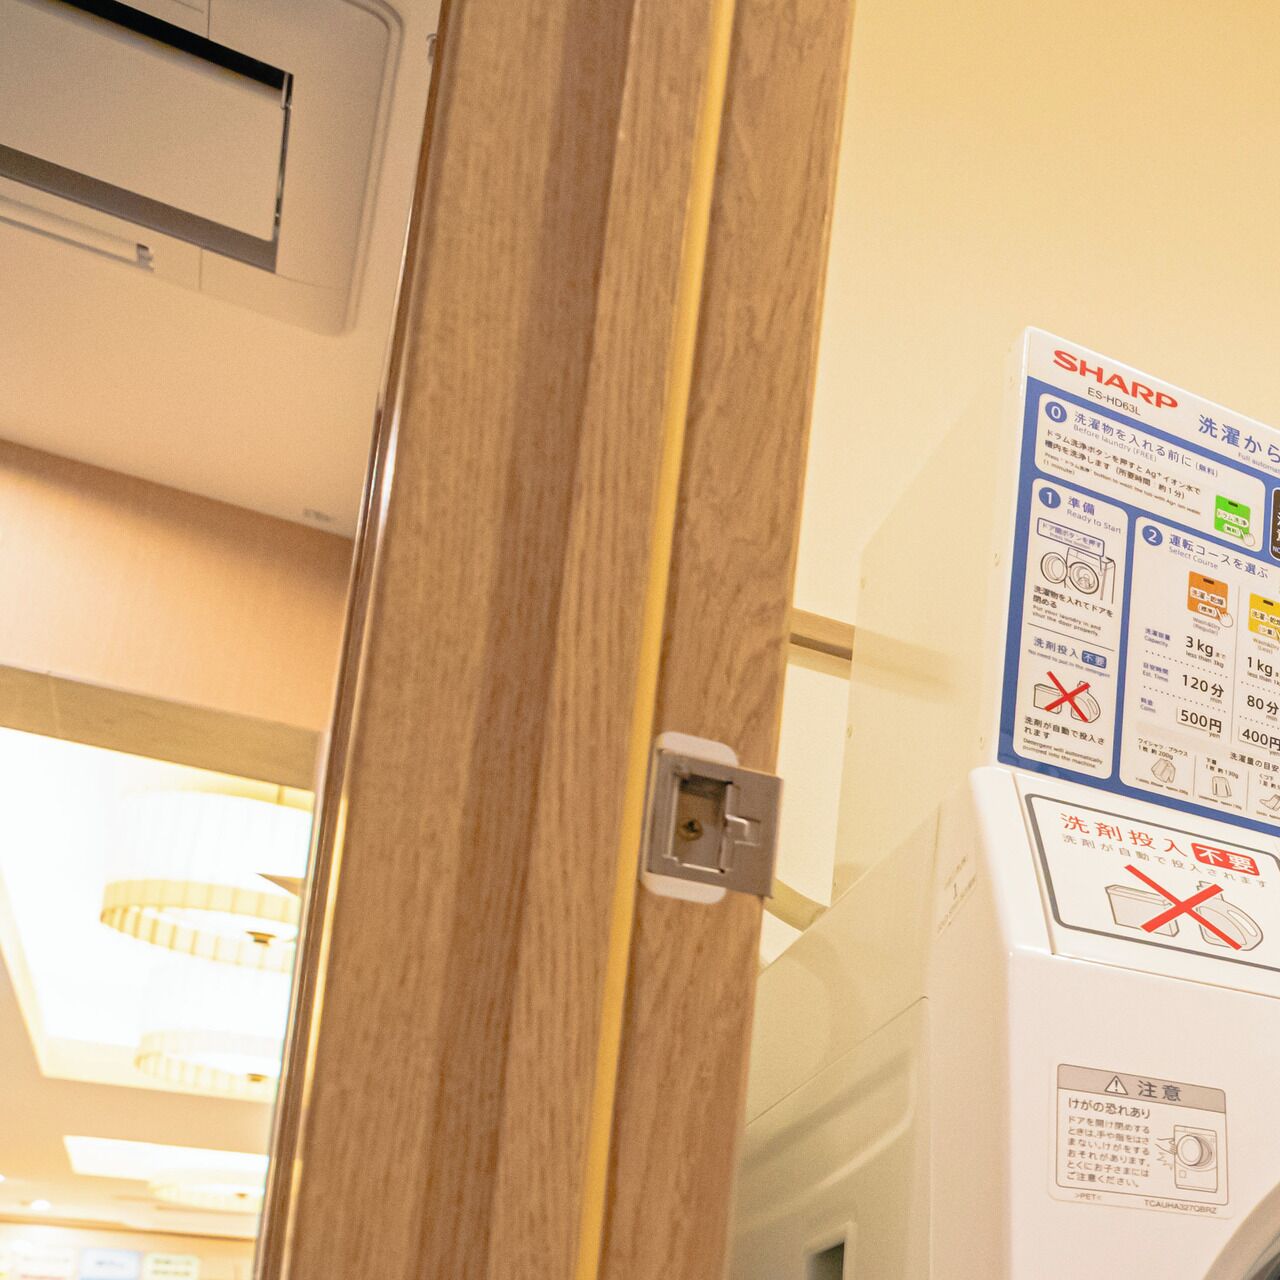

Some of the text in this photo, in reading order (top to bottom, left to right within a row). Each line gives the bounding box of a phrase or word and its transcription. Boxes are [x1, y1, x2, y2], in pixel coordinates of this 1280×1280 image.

[1053, 349, 1178, 409] SHARP
[1087, 385, 1141, 417] ES-HD63L
[1073, 423, 1099, 440] Before
[1100, 433, 1131, 453] laundry
[1073, 410, 1192, 469] 洗濯物を入れる前に
[1067, 495, 1095, 516] 準備
[1066, 508, 1121, 534] Ready to Start
[1168, 532, 1268, 581] 運転コースを選ぶ
[1168, 545, 1218, 570] Select Course
[1033, 635, 1079, 660] 洗剤投入
[1196, 638, 1213, 658] kg
[1256, 658, 1272, 678] kg
[1181, 672, 1224, 699] 120分
[1246, 693, 1279, 716] 80分
[1024, 716, 1104, 746] 洗剤が自動で投入さ
[1180, 708, 1222, 734] 500円
[1241, 727, 1280, 752] 400円
[1230, 751, 1279, 773] 洗濯量の目安
[1057, 811, 1188, 858] 洗剤投入
[1195, 844, 1257, 875] 不要
[1061, 832, 1269, 889] 洗剤が自動で投入されます
[1137, 1079, 1181, 1102] 注意
[1068, 1097, 1150, 1119] けがの恐れあり
[1068, 1114, 1149, 1134] ドアを開け閉めする
[1066, 1159, 1148, 1177] とくにお子さまには
